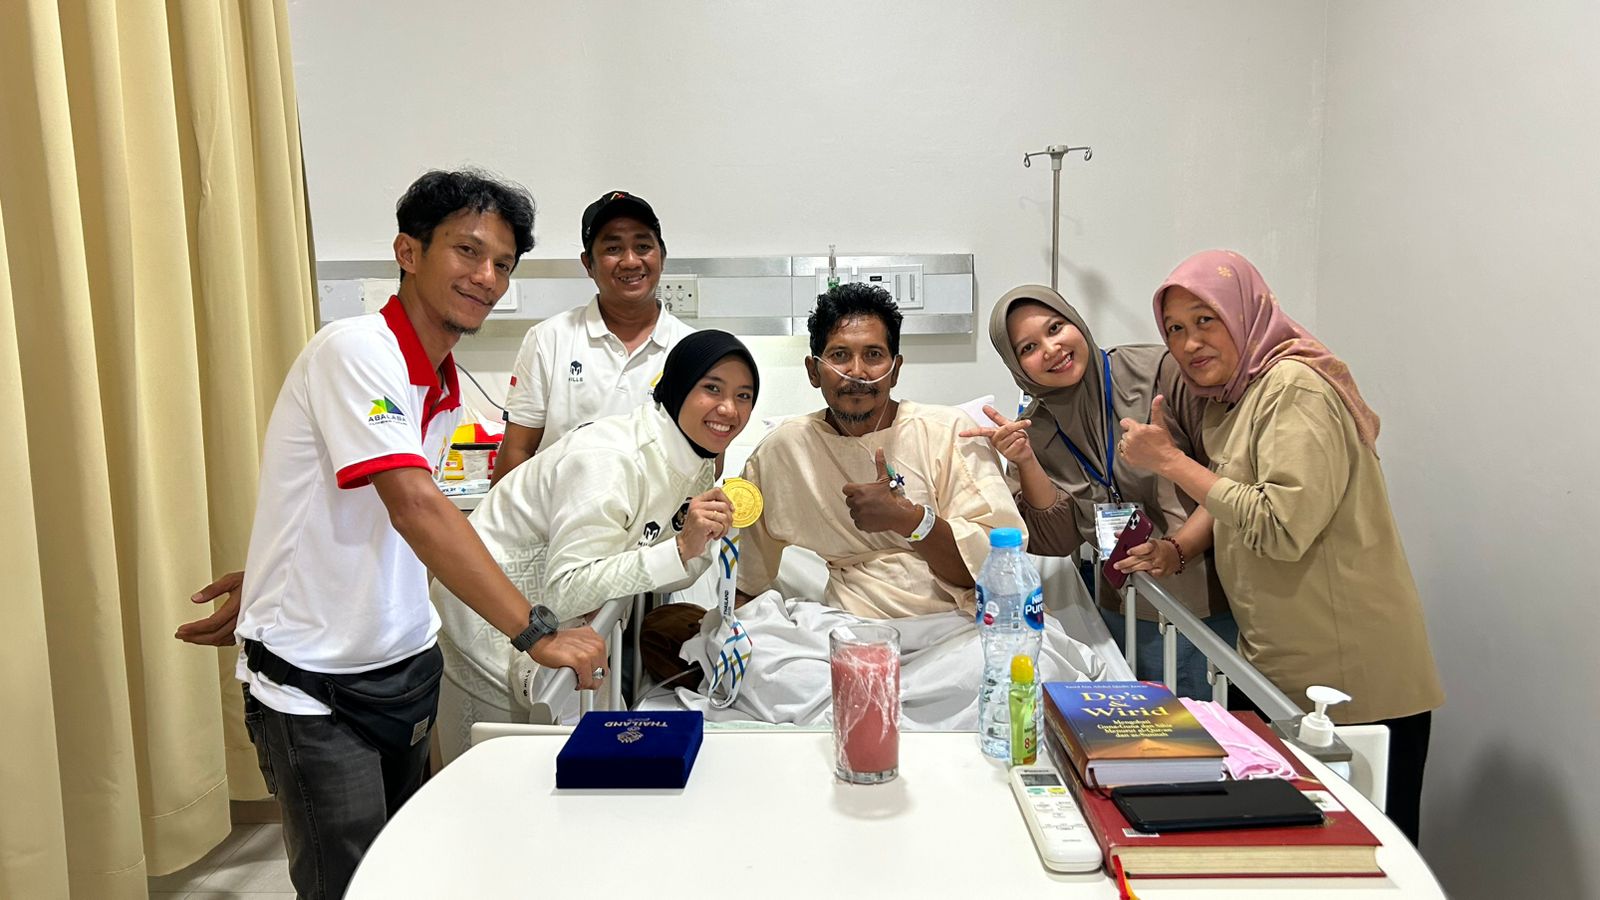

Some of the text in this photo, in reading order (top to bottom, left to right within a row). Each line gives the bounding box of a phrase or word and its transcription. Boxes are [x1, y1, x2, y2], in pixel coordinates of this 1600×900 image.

[1080, 691, 1148, 701] Do'a
[1081, 706, 1169, 717] Wirid
[604, 720, 668, 728] THAILAND
